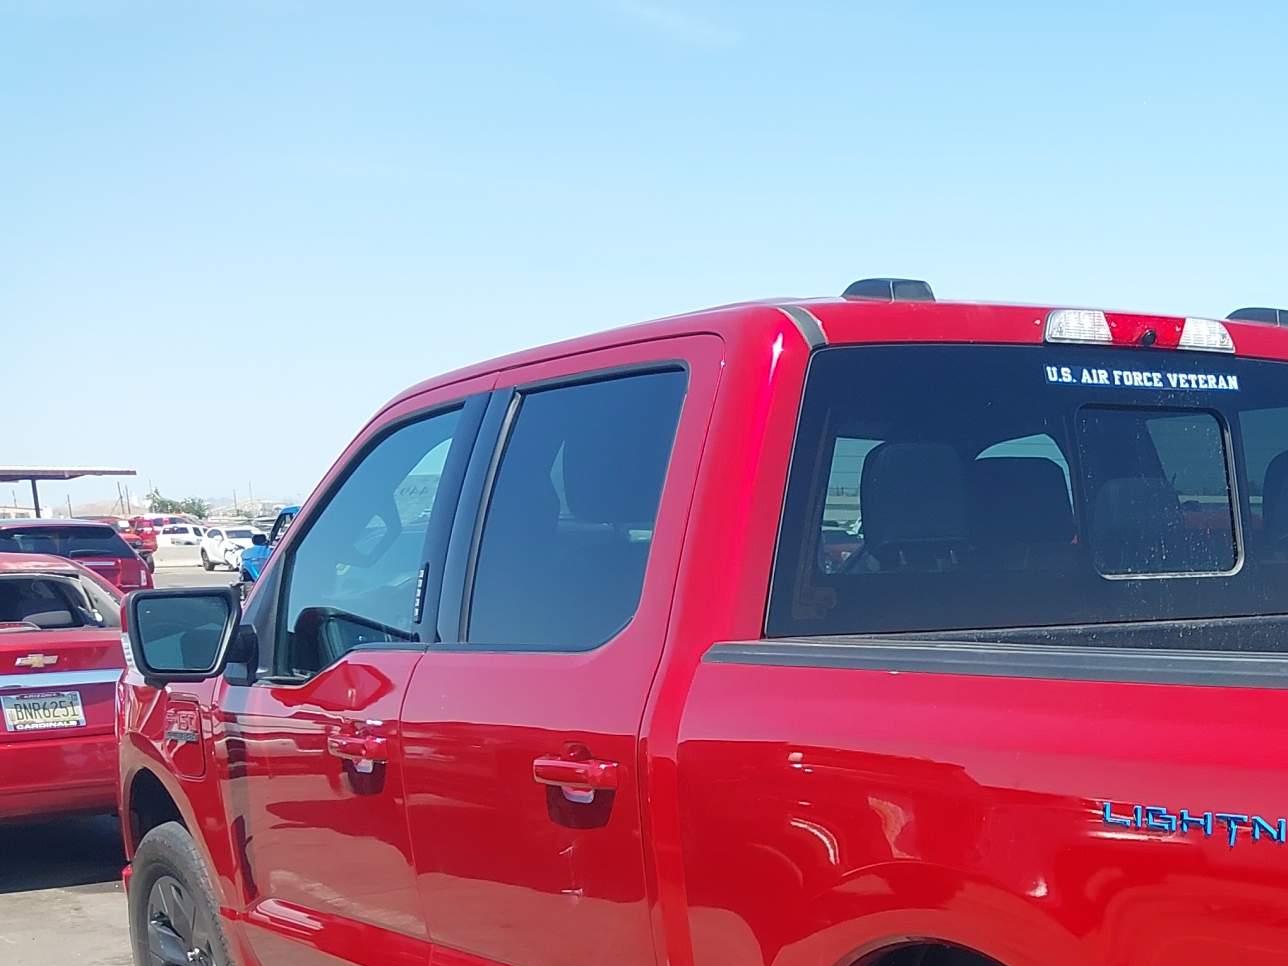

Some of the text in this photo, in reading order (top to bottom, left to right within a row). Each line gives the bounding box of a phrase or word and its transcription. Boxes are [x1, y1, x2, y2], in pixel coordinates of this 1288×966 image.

[1046, 366, 1239, 391] U.S. AIR FORCE VETERAN
[14, 700, 79, 721] BNR6251
